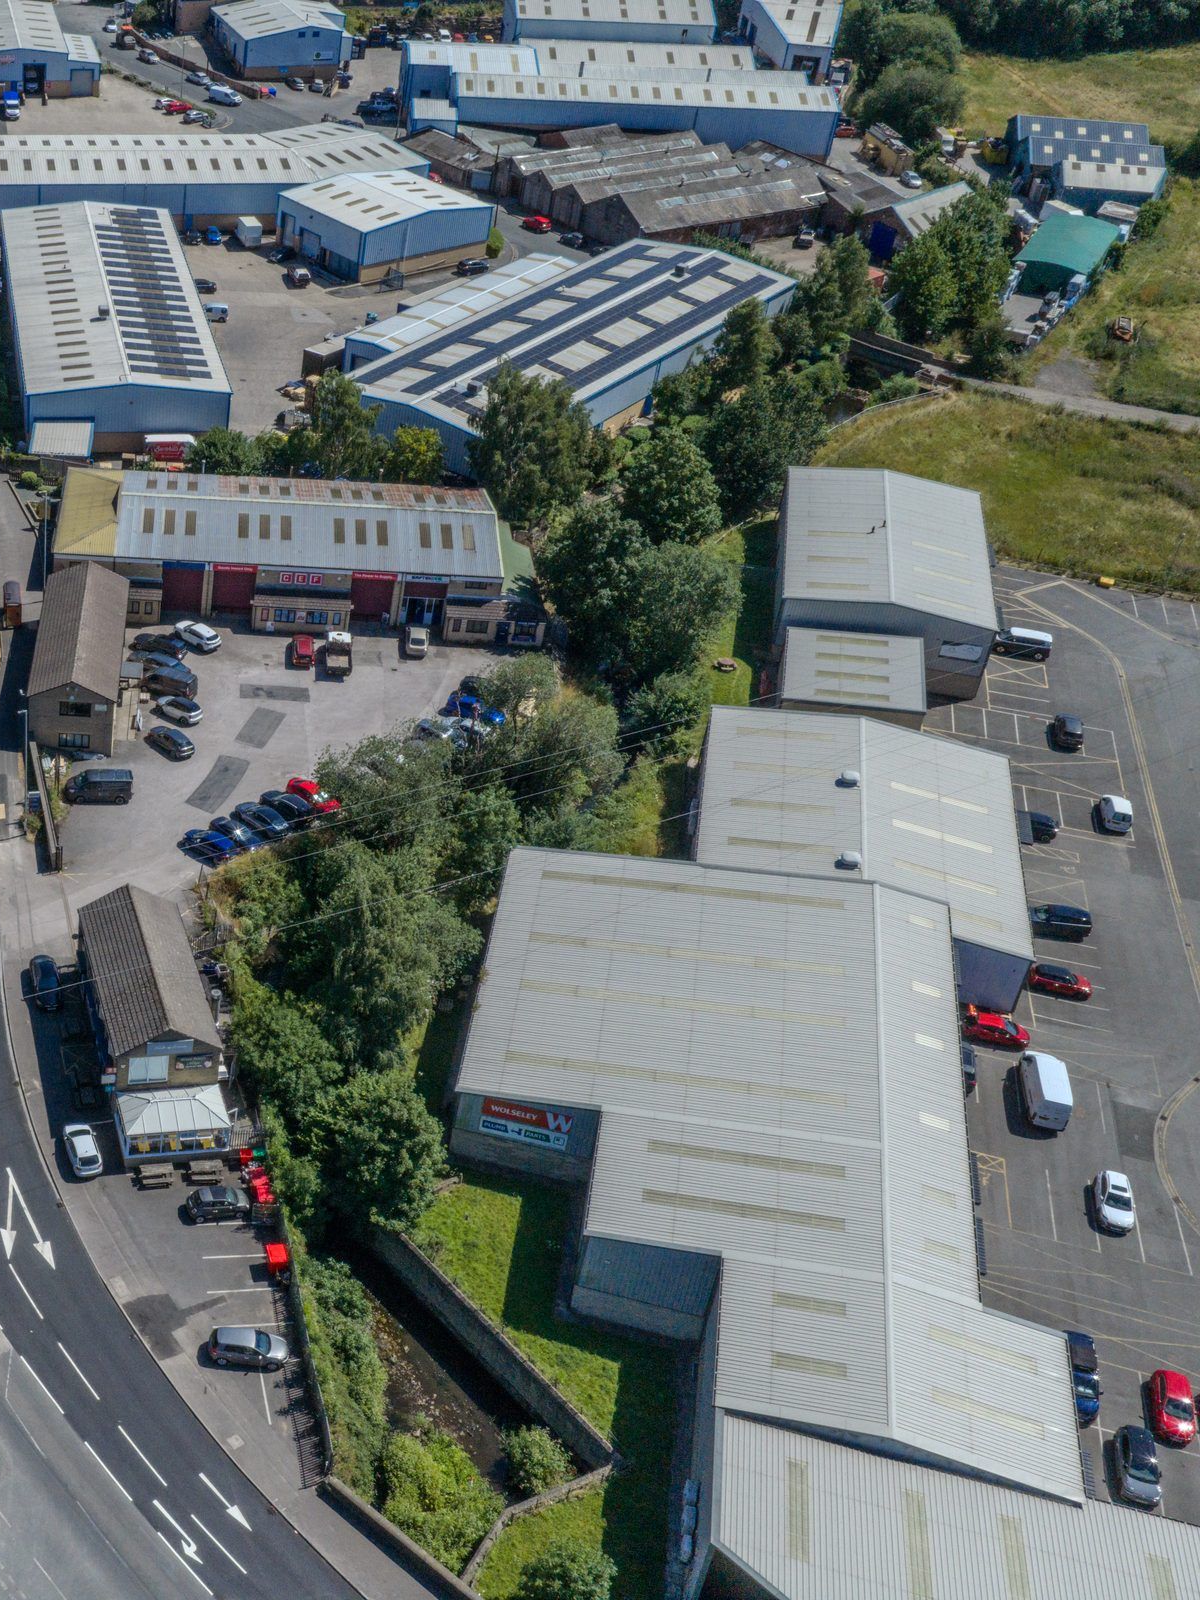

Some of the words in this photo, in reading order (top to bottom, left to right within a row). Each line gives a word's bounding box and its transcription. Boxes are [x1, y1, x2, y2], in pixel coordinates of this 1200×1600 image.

[491, 1105, 538, 1120] WOLSELEY
[484, 1121, 506, 1131] PLUMB
[526, 1130, 546, 1140] PARTS
